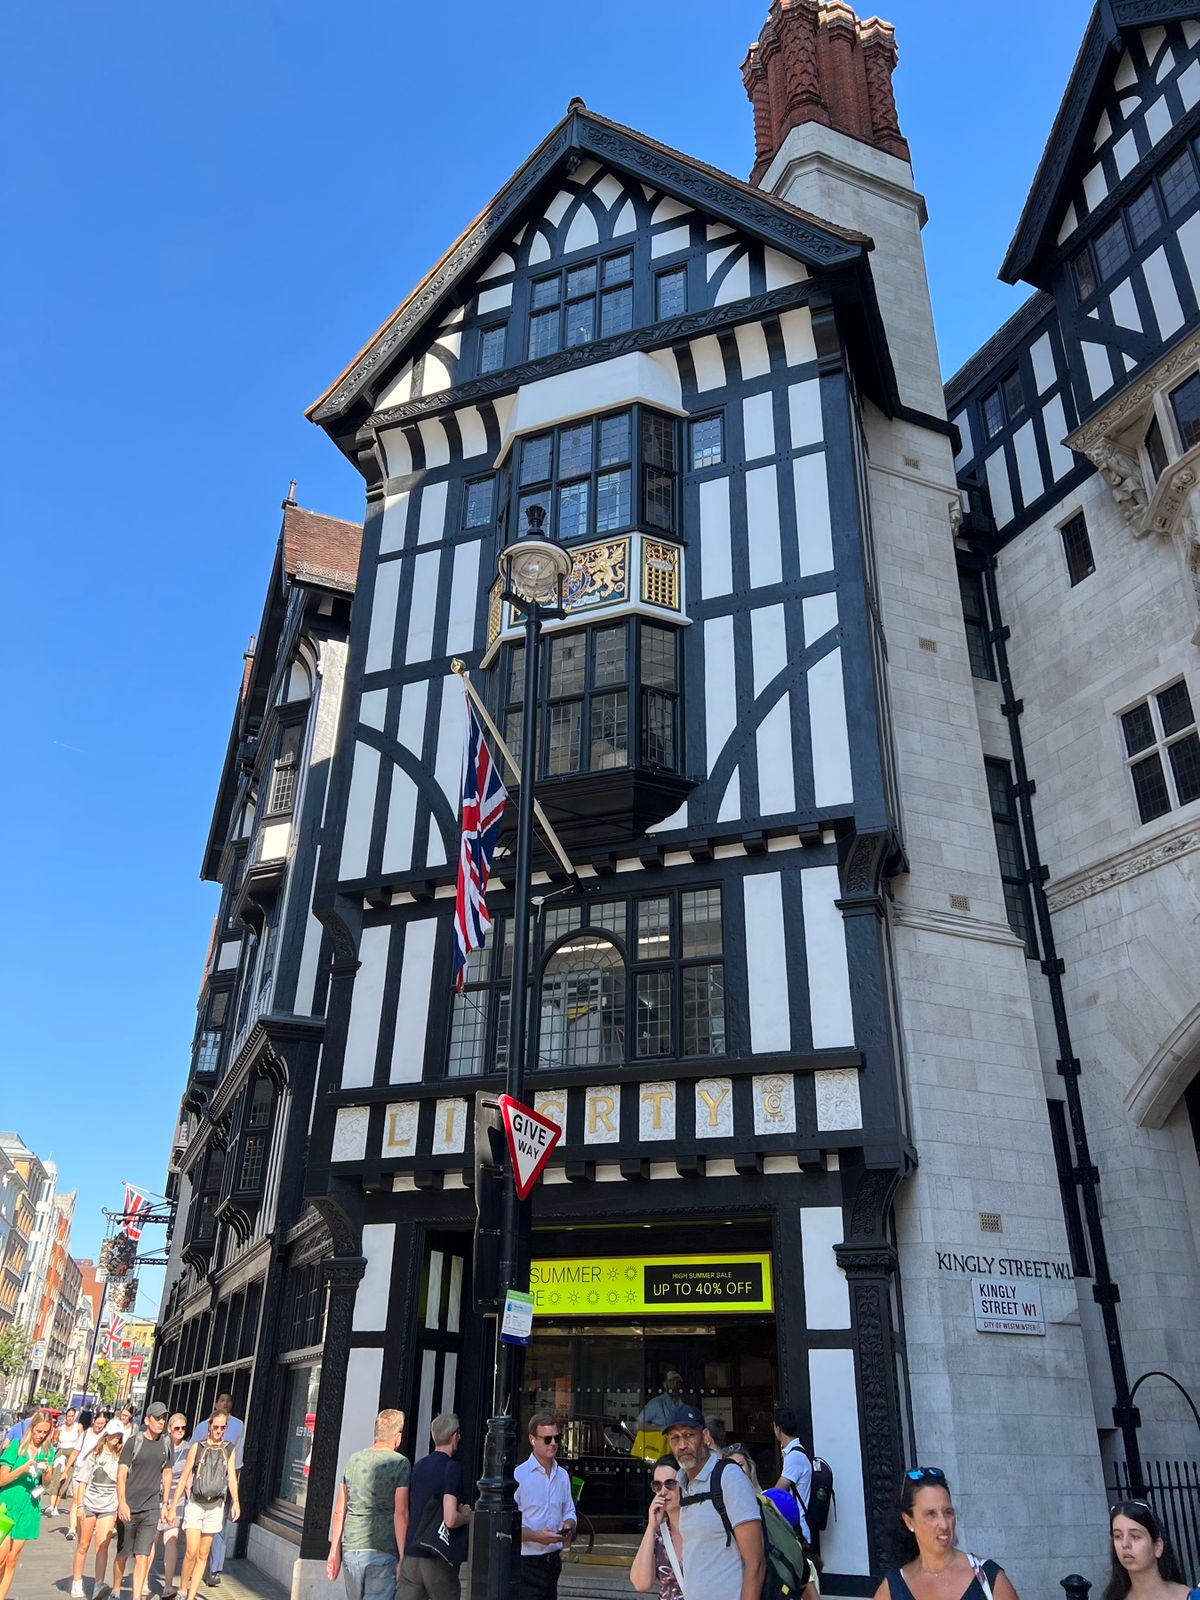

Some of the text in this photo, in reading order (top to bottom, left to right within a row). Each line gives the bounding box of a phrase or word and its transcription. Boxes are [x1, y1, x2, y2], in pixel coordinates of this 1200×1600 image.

[513, 1114, 546, 1147] GIVE
[518, 1138, 539, 1159] WAY
[936, 1252, 995, 1274] KINGLY
[530, 1266, 601, 1284] SUMMER
[689, 1271, 715, 1279] SUMMER
[653, 1281, 752, 1296] UP TO 40% OFF
[979, 1284, 1016, 1299] KINGLY
[981, 1300, 1037, 1317] STREET W1
[983, 1321, 995, 1329] CITY
[1002, 1323, 1036, 1331] WESTMINSTER
